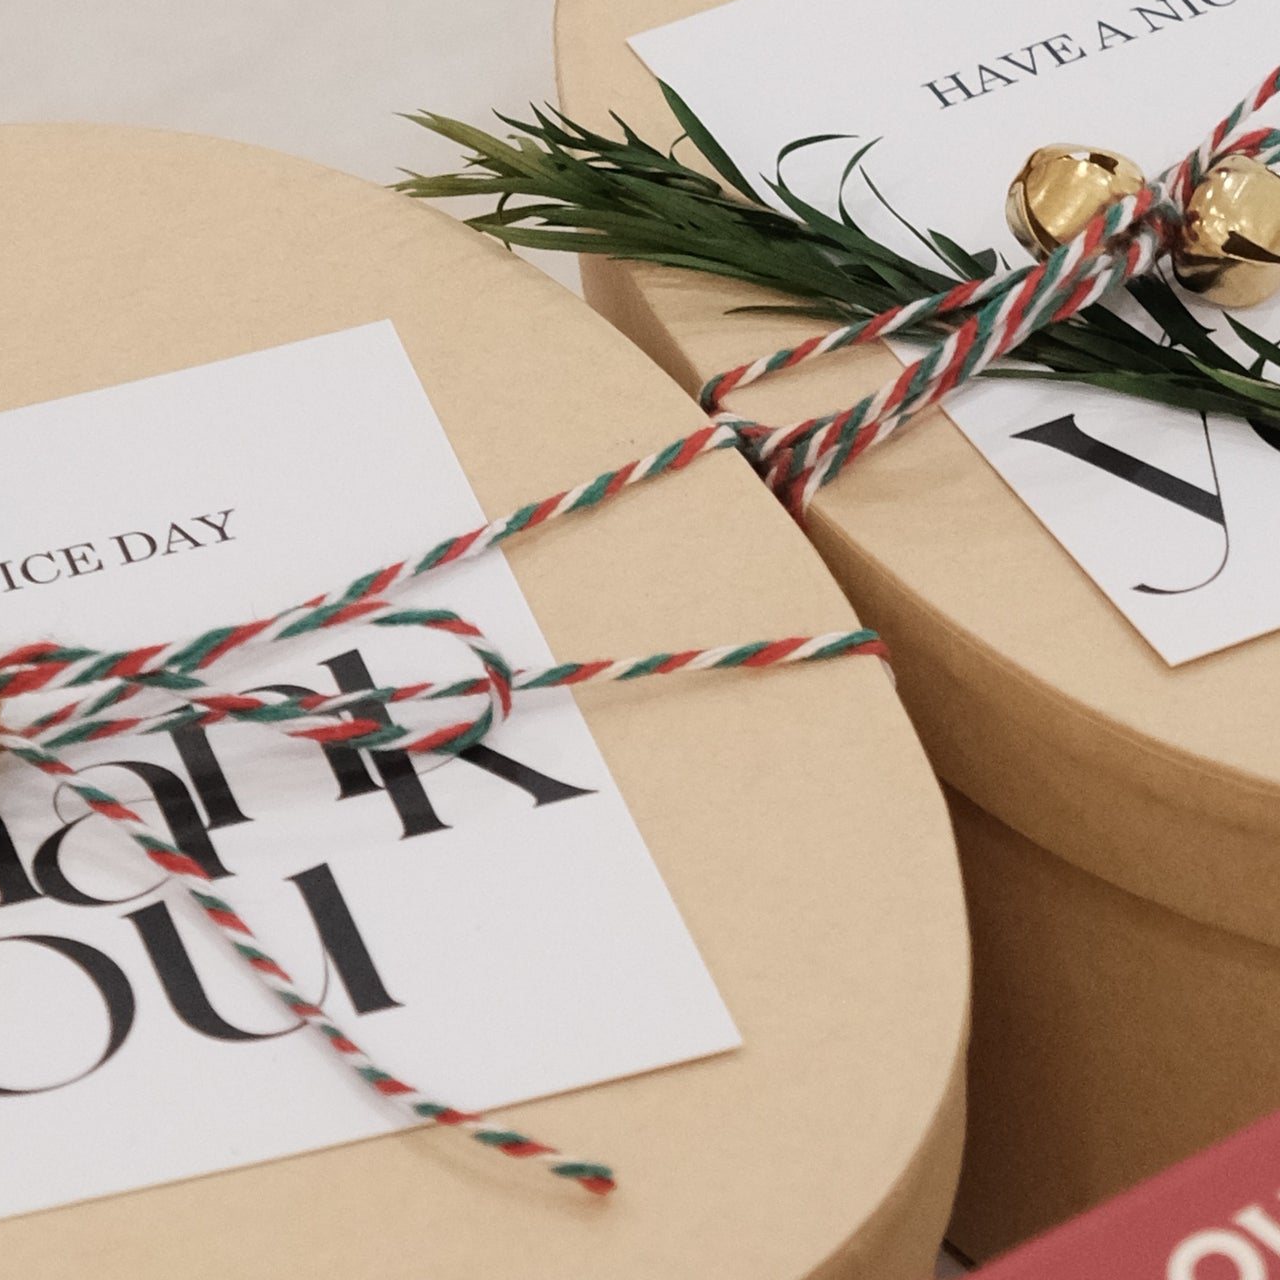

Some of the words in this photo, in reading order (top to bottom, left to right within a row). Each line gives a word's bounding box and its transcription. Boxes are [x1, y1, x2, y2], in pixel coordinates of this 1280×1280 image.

[921, 32, 1088, 110] HAVE
[1096, 19, 1137, 51] A
[108, 508, 238, 566] DAY
